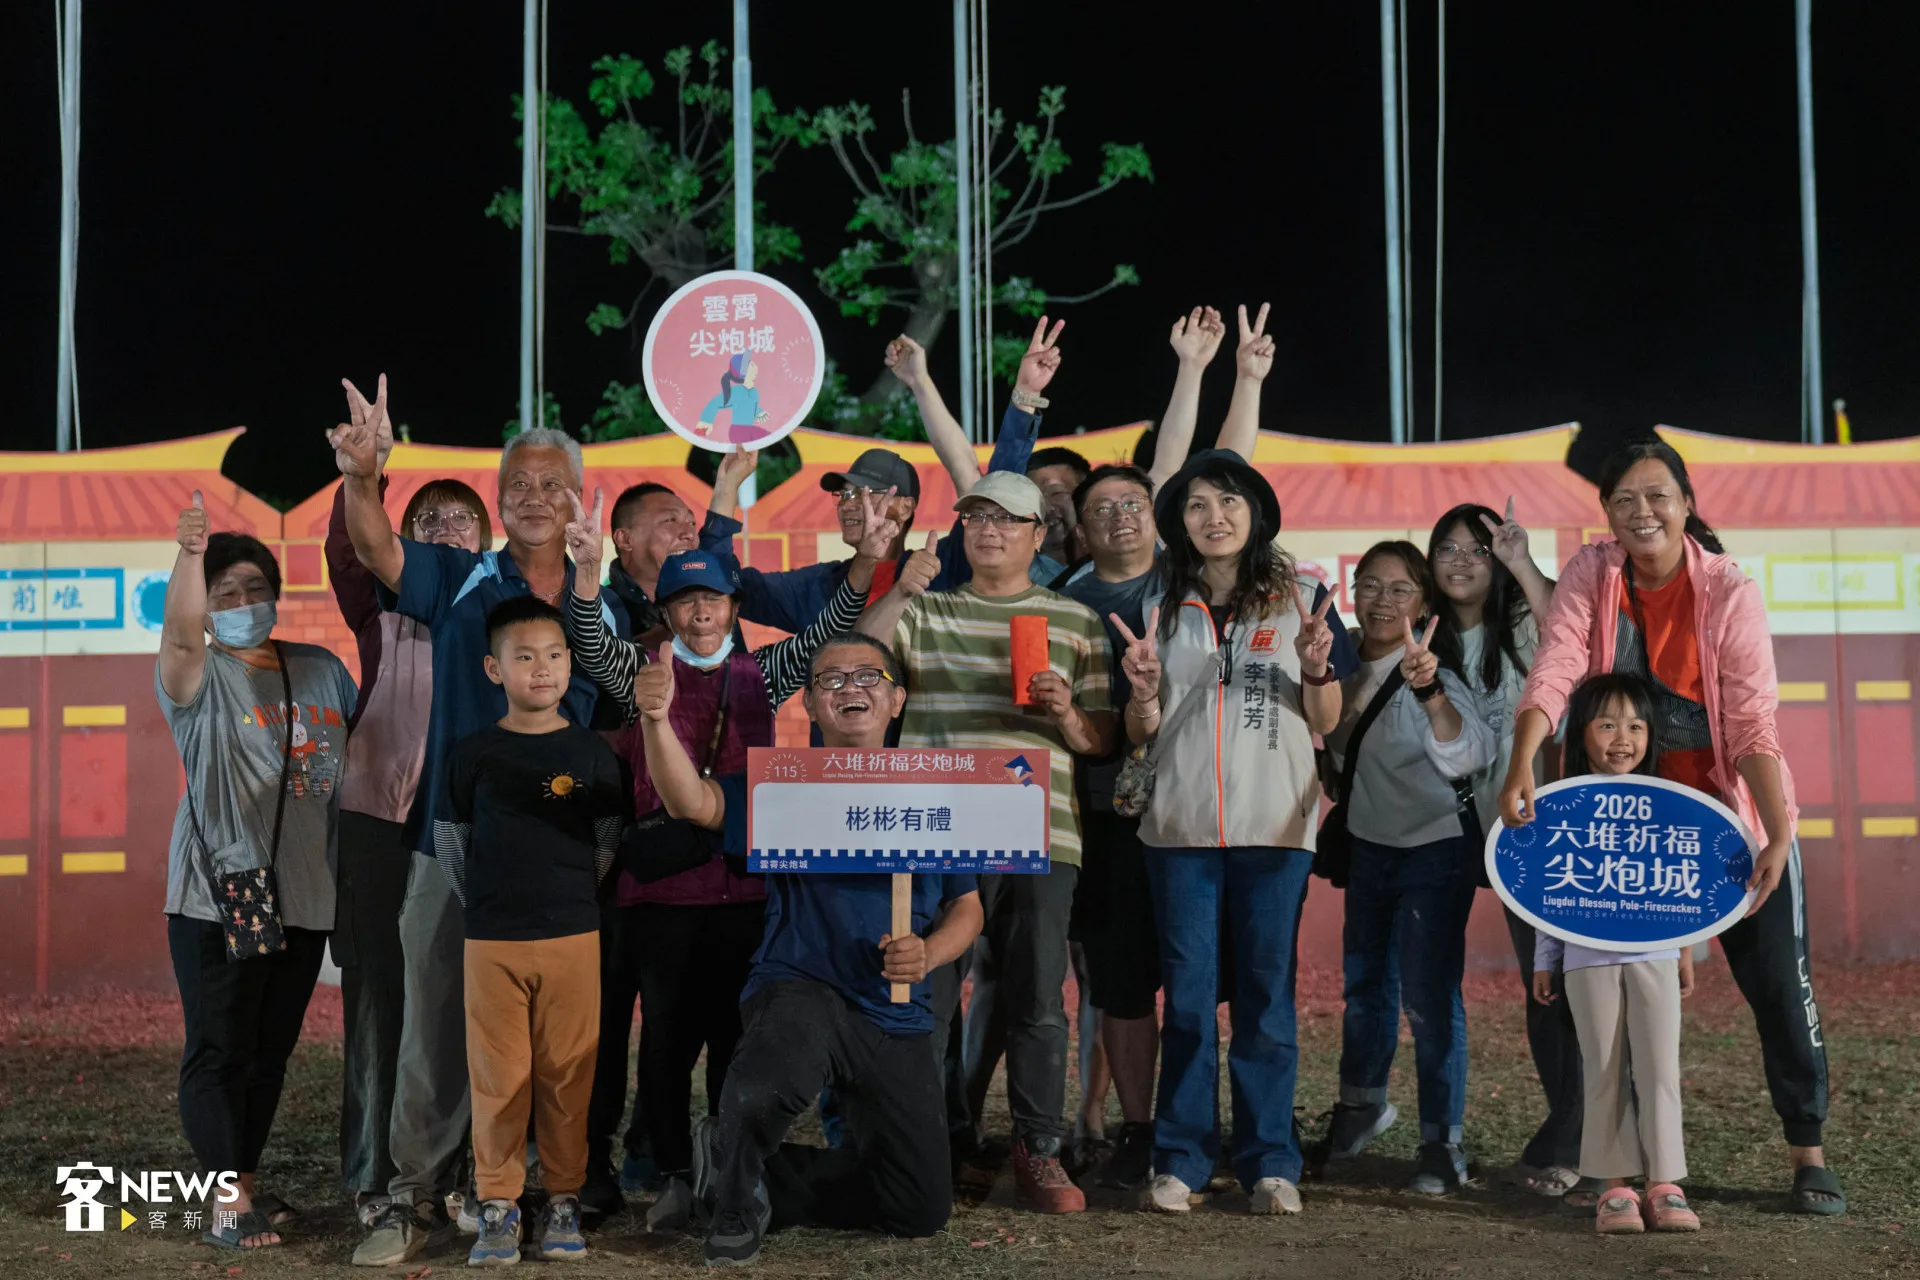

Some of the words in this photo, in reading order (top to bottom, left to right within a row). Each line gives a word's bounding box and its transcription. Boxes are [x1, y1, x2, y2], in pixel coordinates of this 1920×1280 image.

[702, 293, 759, 323] 雲霄
[689, 325, 776, 357] 尖炮城
[1244, 662, 1266, 729] 李昀芳
[774, 765, 798, 778] 115
[822, 753, 976, 772] 六堆祈福尖炮城
[846, 805, 952, 832] 彬彬有禮
[1593, 794, 1652, 820] 2026
[1546, 820, 1701, 856] 六堆祈福
[1544, 852, 1702, 899] 尖炮城
[1543, 895, 1576, 908] Liugdui
[1579, 897, 1617, 911] Blessing
[1620, 899, 1702, 914] Pole-Firecrackers
[1543, 907, 1591, 918] Beating
[1594, 910, 1633, 920] Series
[1637, 911, 1701, 924] Activities
